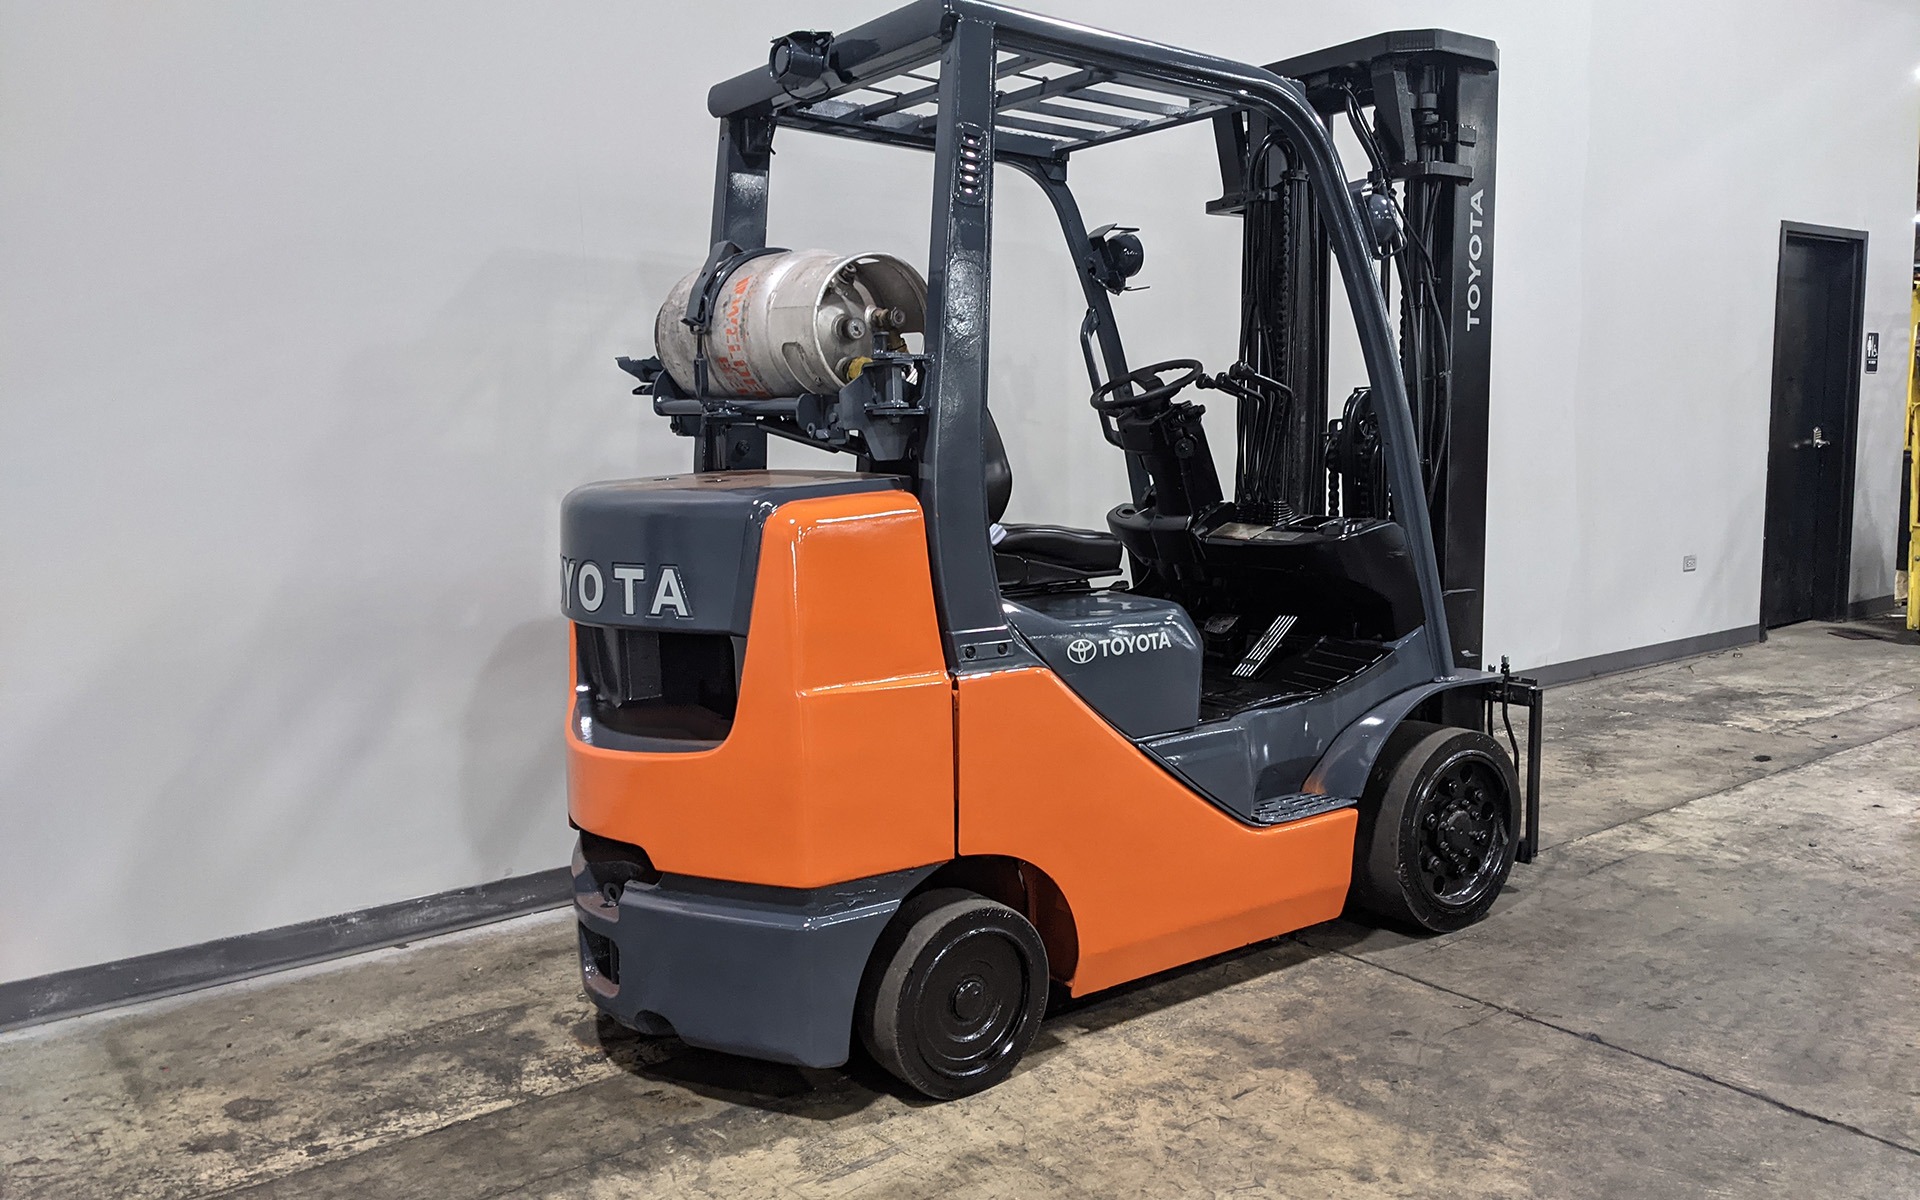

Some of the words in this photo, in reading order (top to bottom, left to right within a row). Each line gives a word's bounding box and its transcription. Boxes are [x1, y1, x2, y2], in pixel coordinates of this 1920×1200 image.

[1467, 188, 1484, 331] TOYOTA
[560, 560, 690, 617] YOTA
[1098, 631, 1172, 657] TOYOTA
